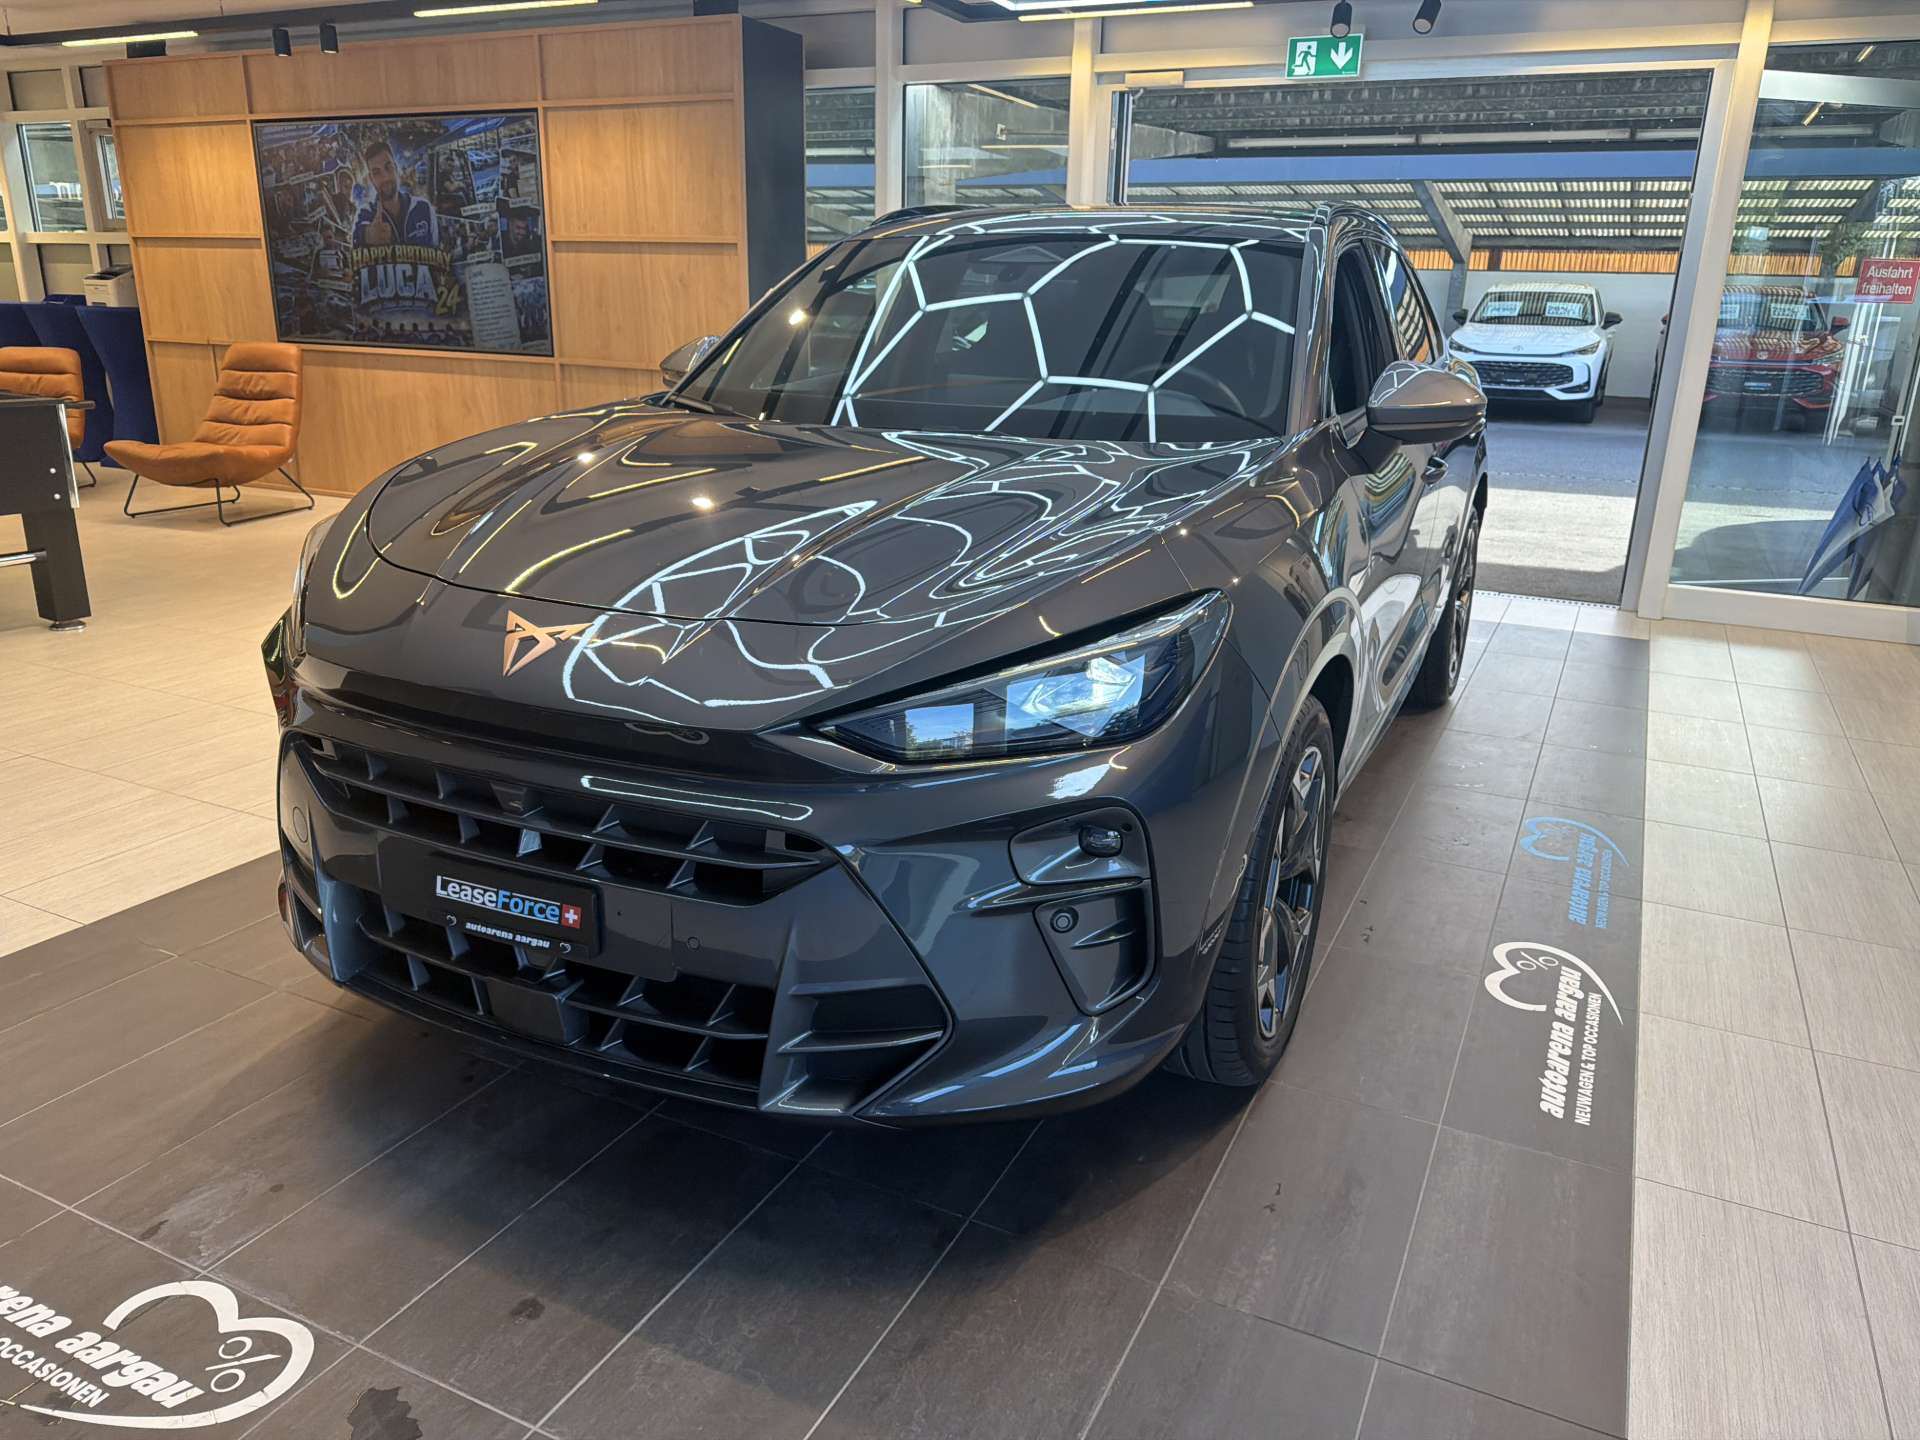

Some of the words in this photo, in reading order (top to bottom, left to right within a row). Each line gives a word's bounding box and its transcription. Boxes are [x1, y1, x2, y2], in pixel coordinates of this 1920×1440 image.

[352, 246, 393, 270] HAPPY
[395, 245, 451, 271] BIRTHDAY
[1866, 266, 1913, 279] Ausfahrt
[360, 263, 439, 305] LUCA
[435, 284, 465, 316] 24
[1861, 281, 1912, 295] freihalten
[435, 875, 561, 922] LeaseForce
[465, 921, 514, 940] autoarena
[514, 933, 551, 949] aargau
[1554, 965, 1585, 1022] aargau
[1583, 992, 1602, 1045] OCCASIONEN
[1538, 1021, 1575, 1120] autoarena
[1580, 1043, 1597, 1062] TOP
[1580, 1062, 1596, 1071] &
[1574, 1069, 1595, 1126] NEUWAGEN
[55, 1331, 205, 1408] aargau
